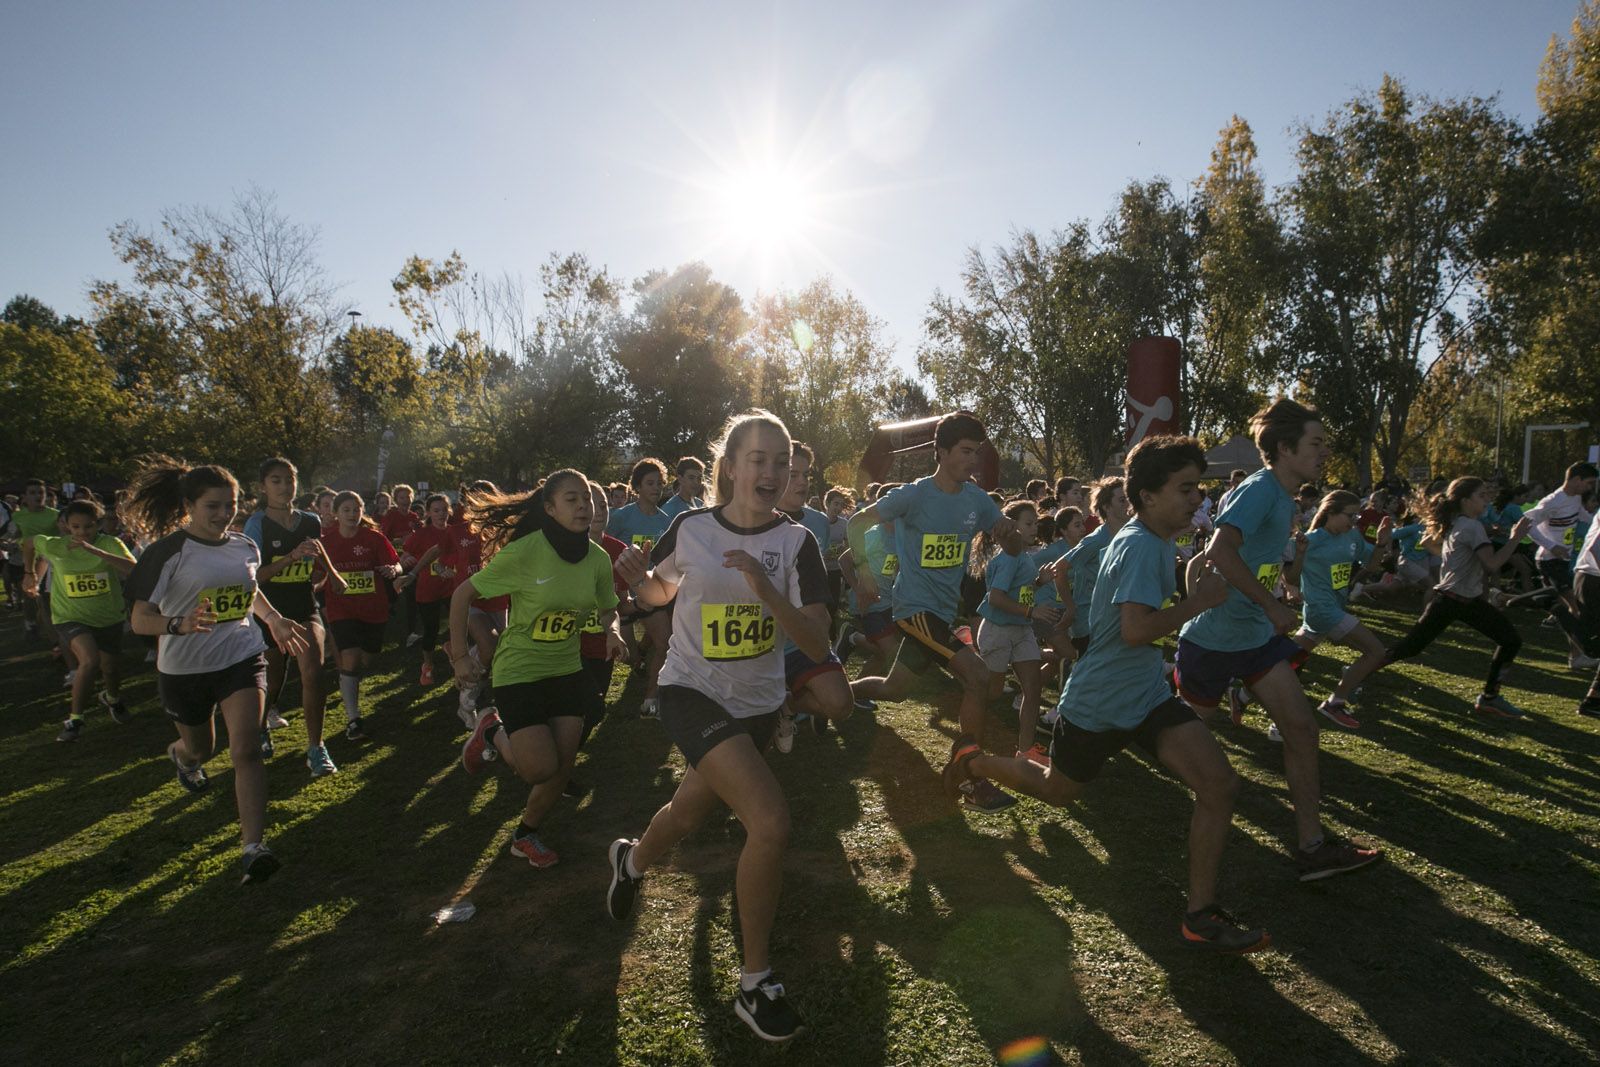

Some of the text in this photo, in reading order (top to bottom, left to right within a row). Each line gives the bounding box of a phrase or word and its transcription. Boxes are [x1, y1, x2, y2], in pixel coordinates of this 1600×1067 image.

[924, 543, 963, 561] 2831
[68, 579, 108, 593] 1663
[344, 577, 373, 591] 592
[706, 615, 775, 647] 1646
